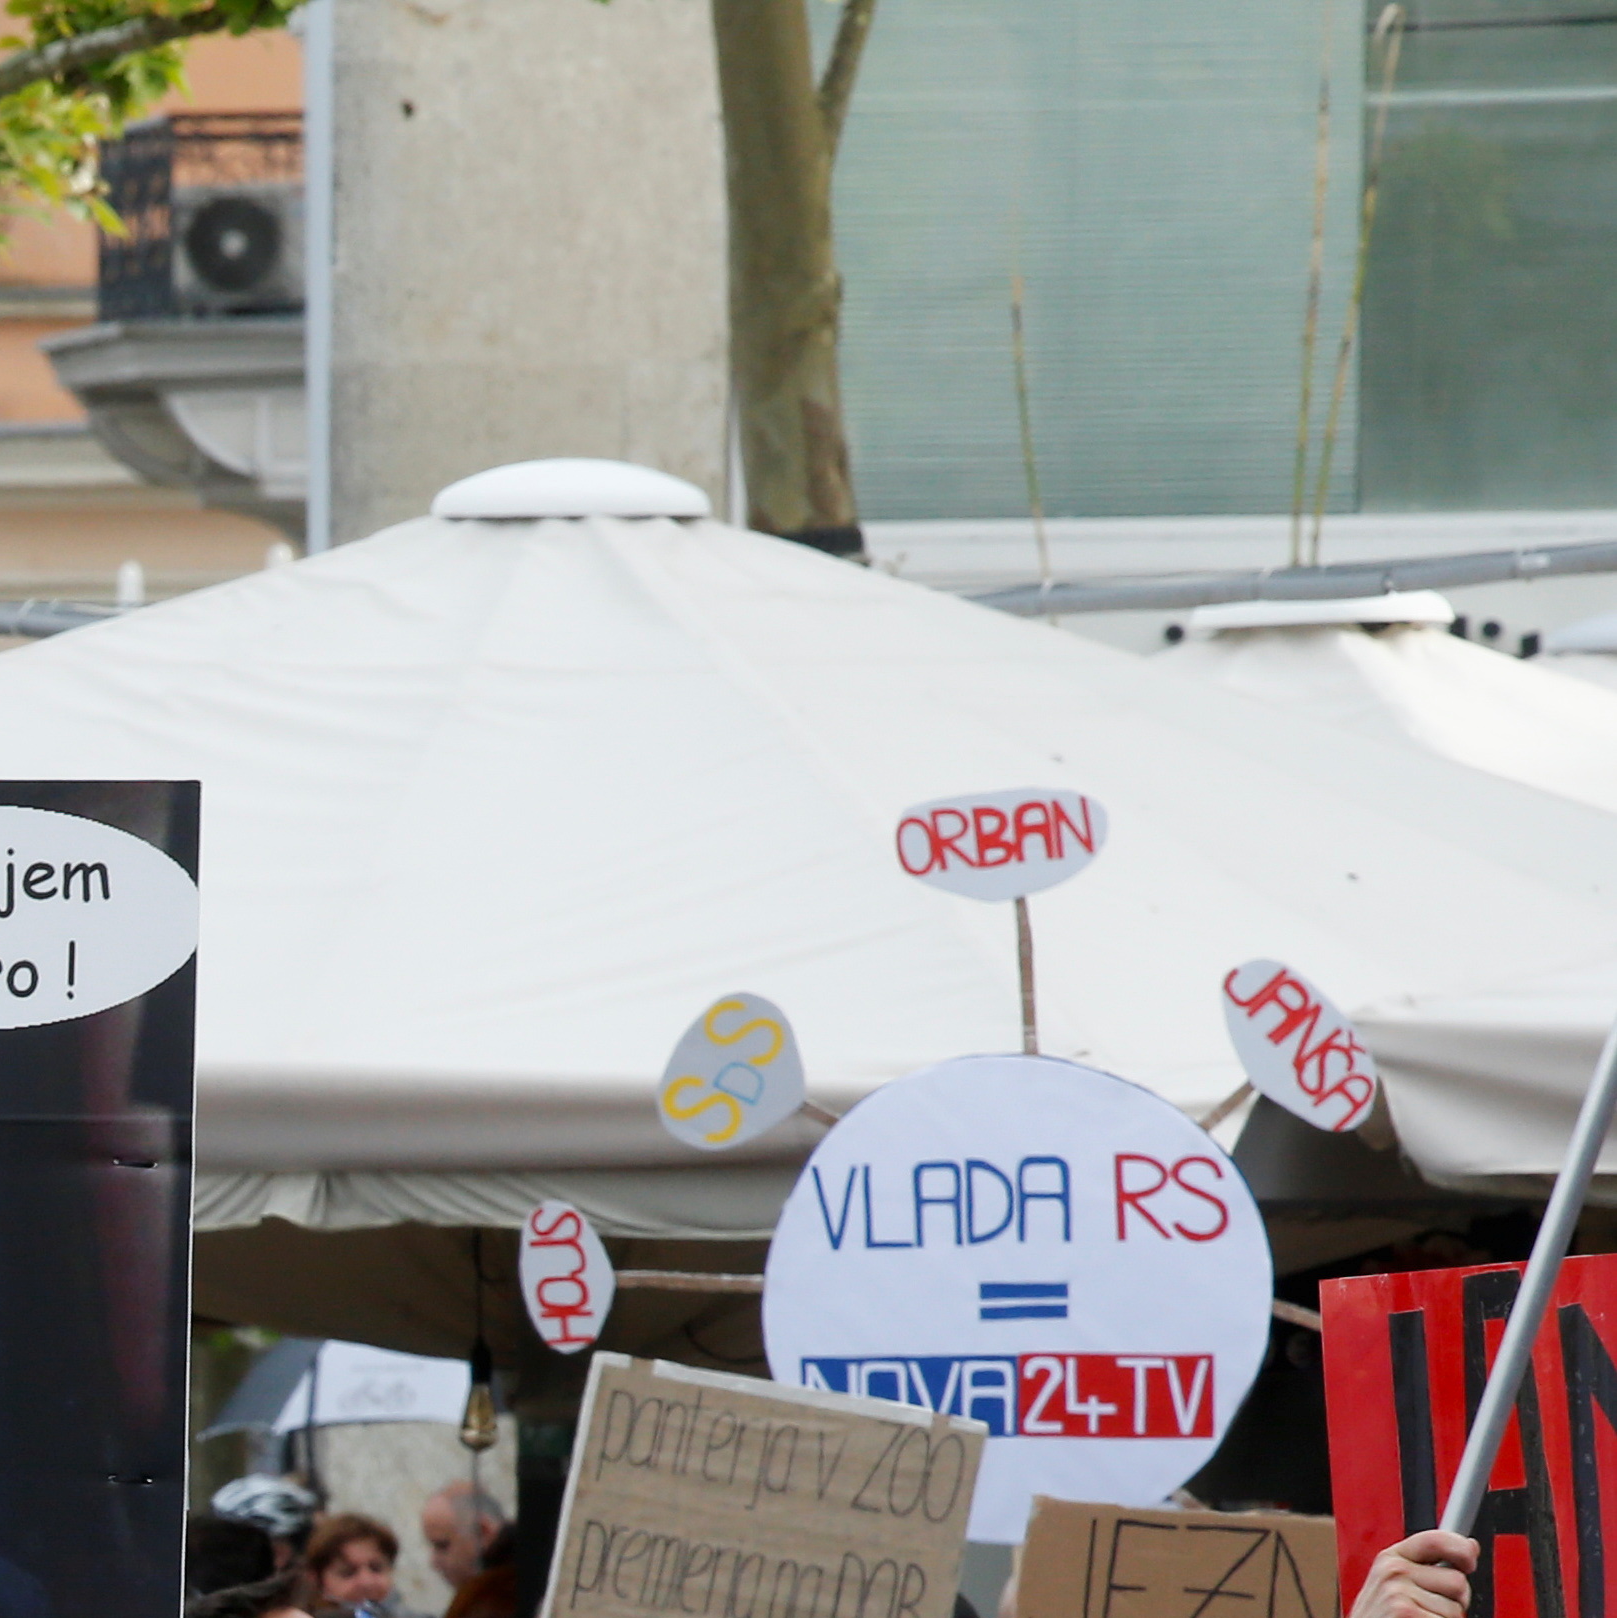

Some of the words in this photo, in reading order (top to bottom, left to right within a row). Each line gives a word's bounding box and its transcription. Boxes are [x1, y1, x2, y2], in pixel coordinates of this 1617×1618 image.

[897, 796, 1095, 876] ORBAN
[66, 940, 76, 999] !
[663, 1000, 783, 1143] SDS
[1223, 968, 1375, 1132] JANŠA
[813, 1156, 1071, 1250] VLADA
[1115, 1154, 1230, 1242] RS
[530, 1208, 597, 1346] HOJS
[852, 1423, 964, 1523] ZOO
